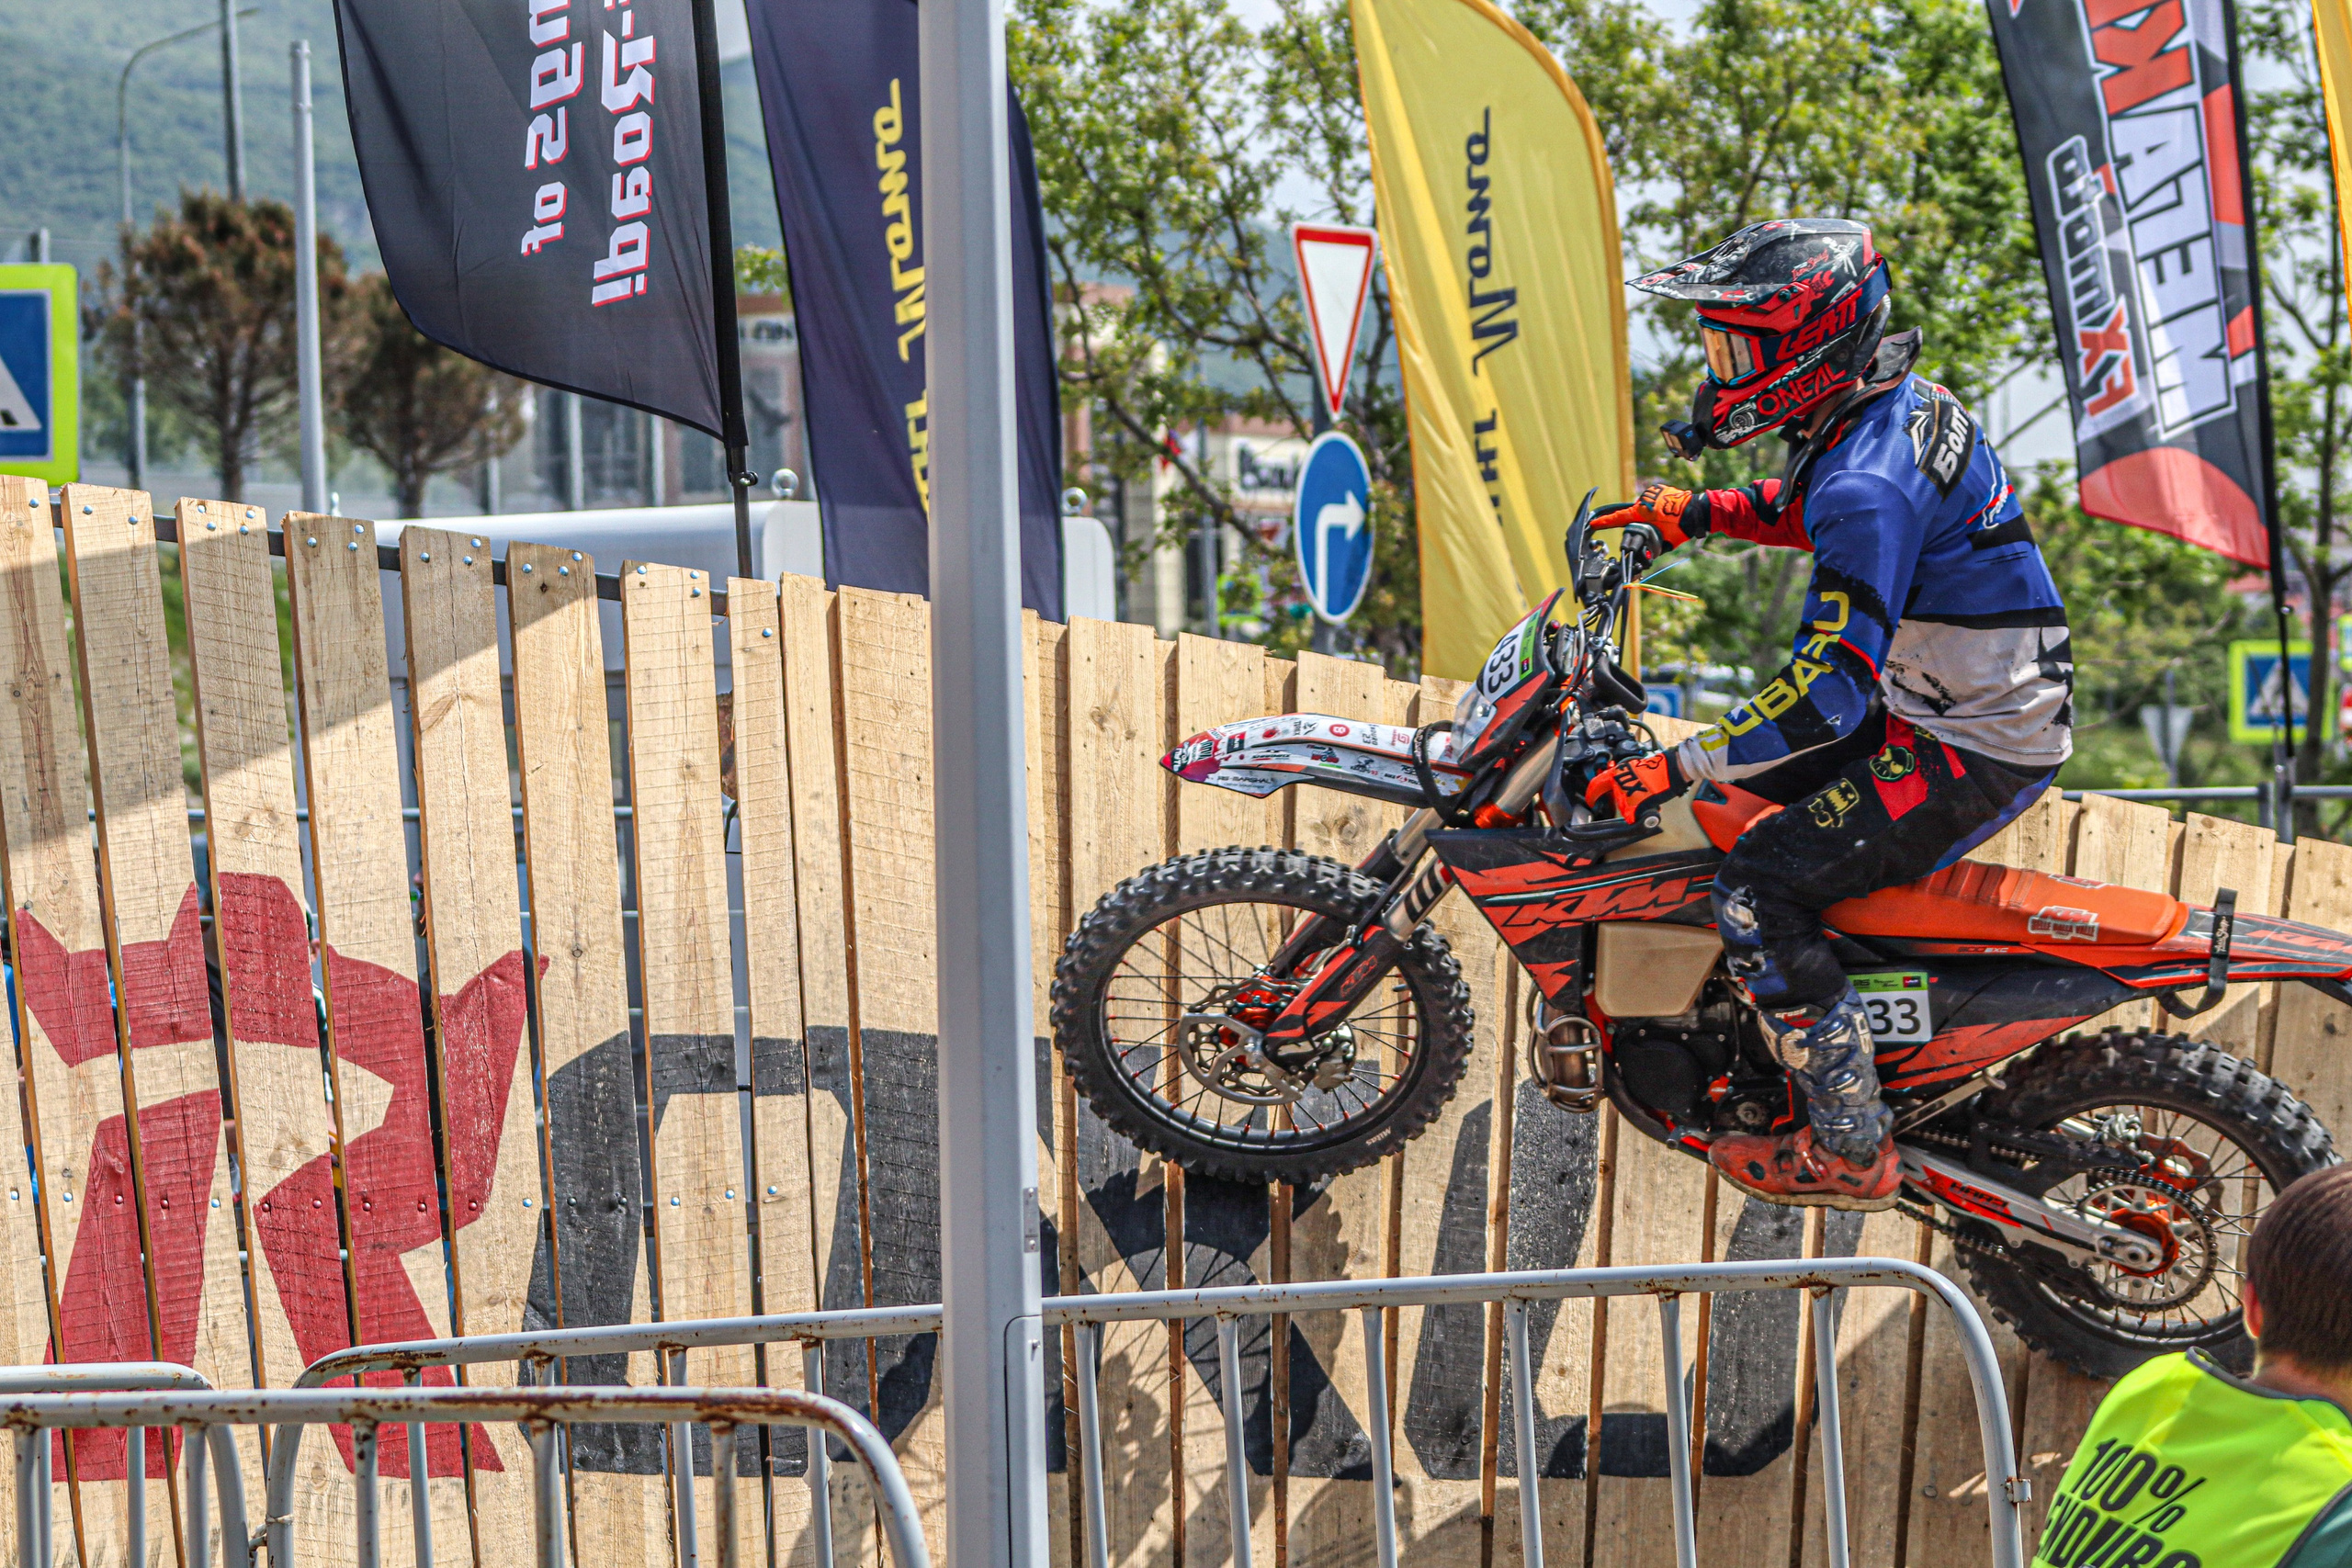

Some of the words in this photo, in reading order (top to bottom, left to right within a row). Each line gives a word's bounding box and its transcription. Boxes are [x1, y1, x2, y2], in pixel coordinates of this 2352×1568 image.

[1775, 288, 1863, 363] LEATT
[1487, 631, 1525, 694] 433
[1502, 877, 1691, 927] KTM
[1866, 998, 1922, 1035] 33
[2070, 1436, 2208, 1534] 100%
